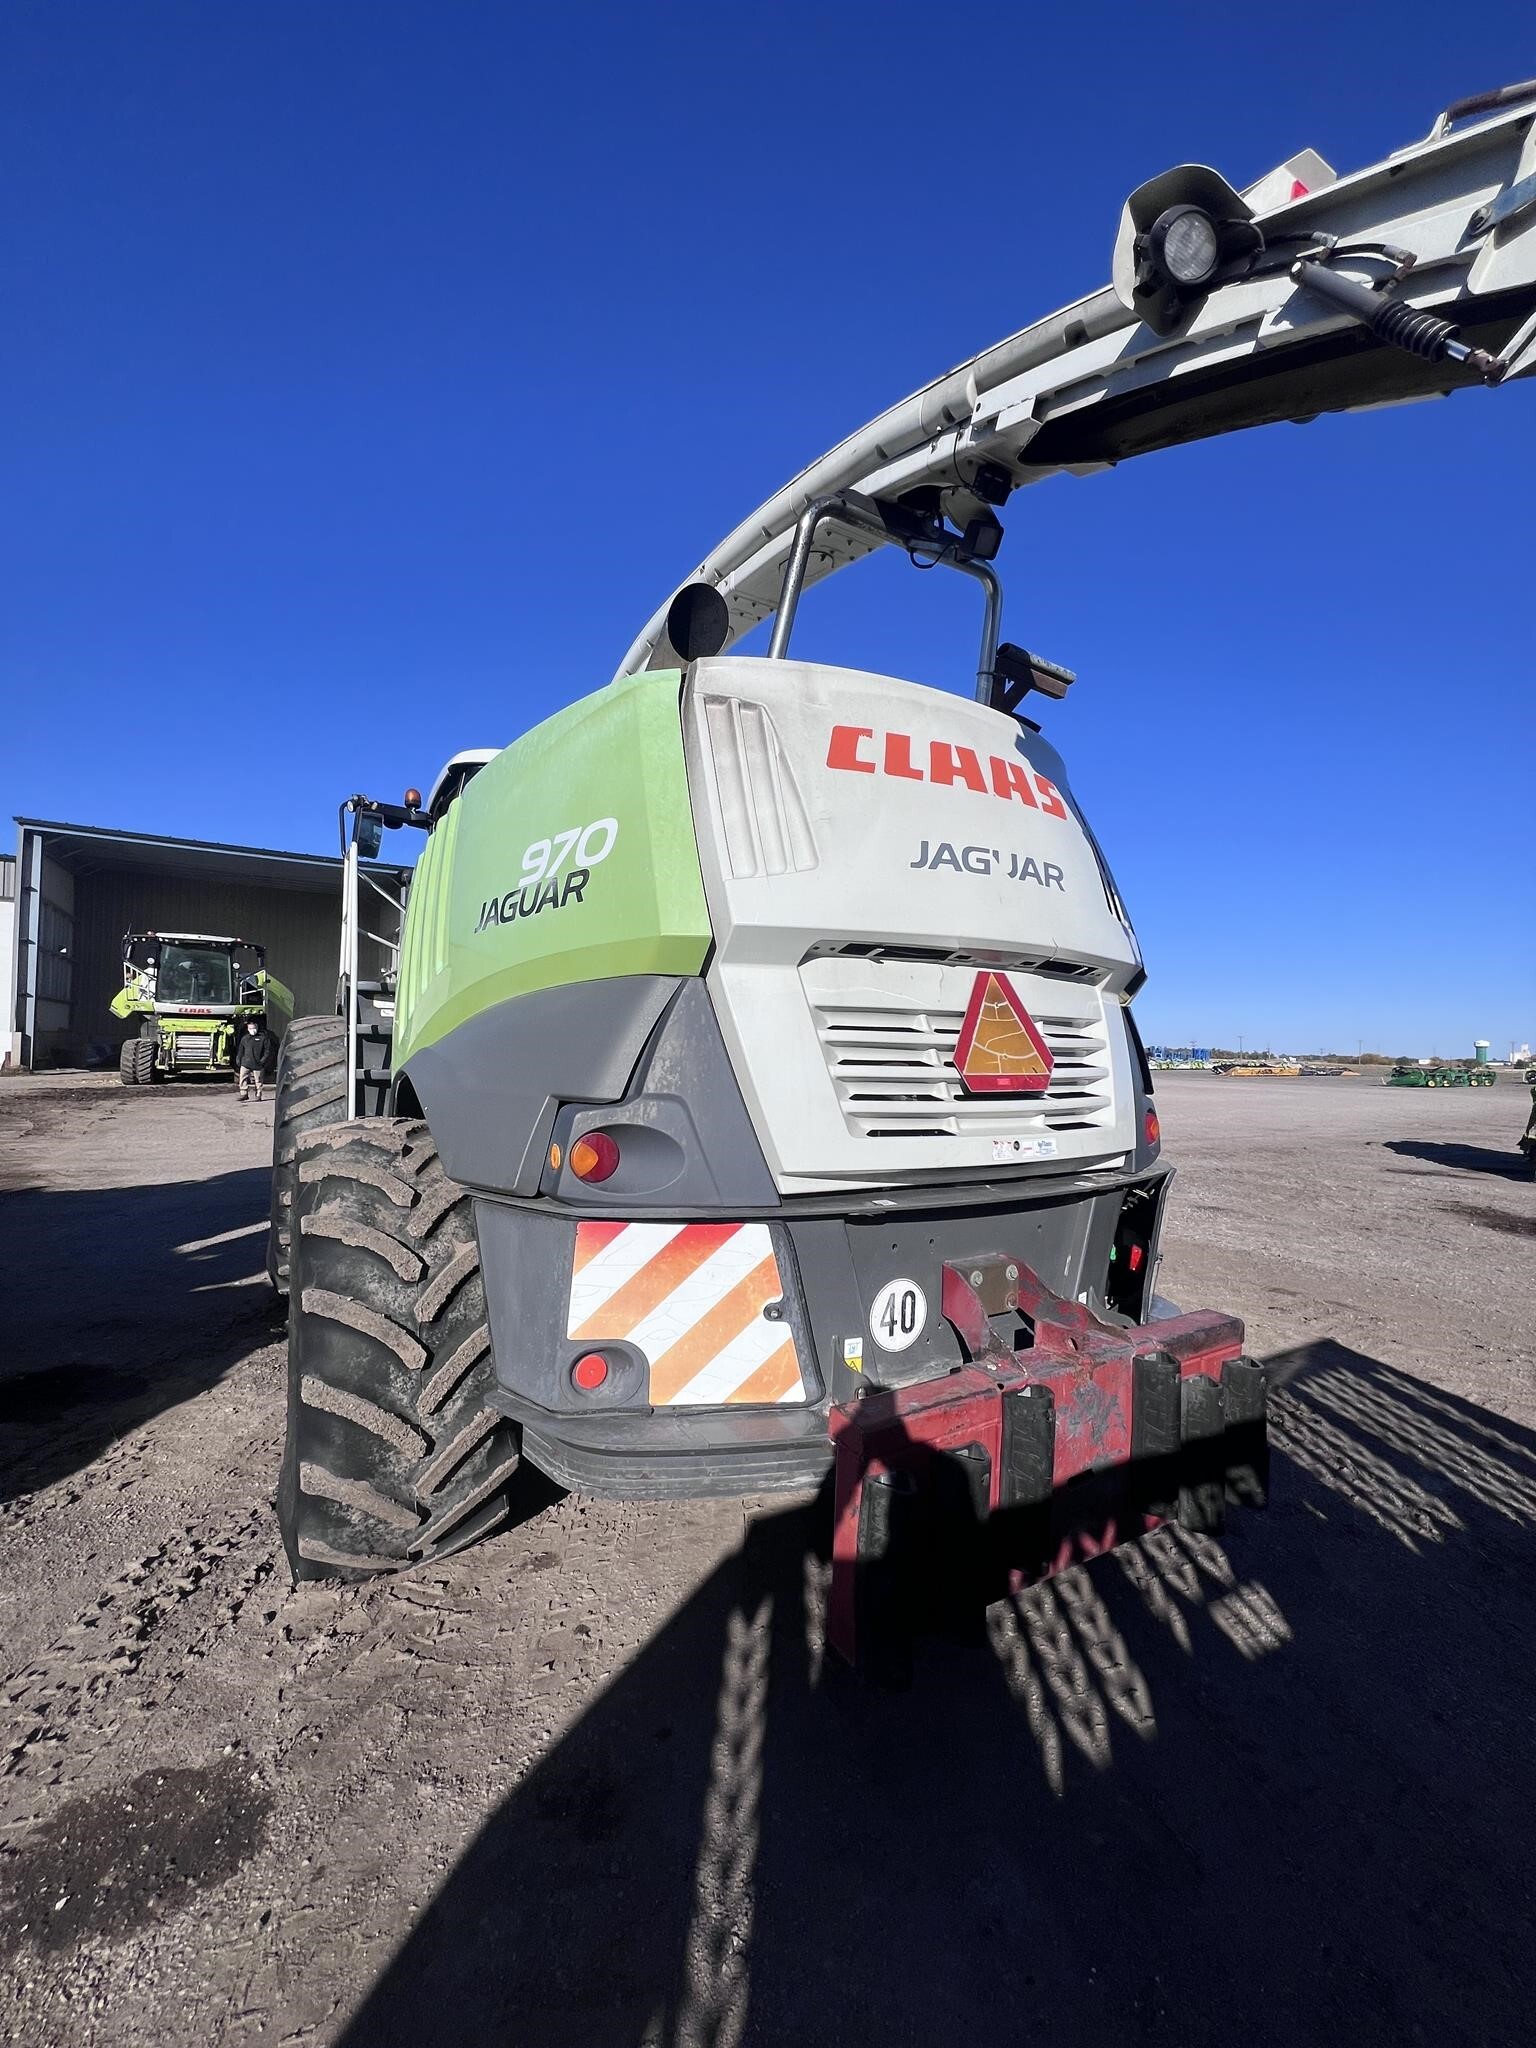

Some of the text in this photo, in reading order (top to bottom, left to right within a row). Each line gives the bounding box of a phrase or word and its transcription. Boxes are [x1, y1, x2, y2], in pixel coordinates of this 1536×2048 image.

[827, 725, 1067, 820] CLAAS
[518, 817, 619, 888] 970
[474, 868, 590, 934] JAGUAR
[880, 1290, 916, 1337] 40
